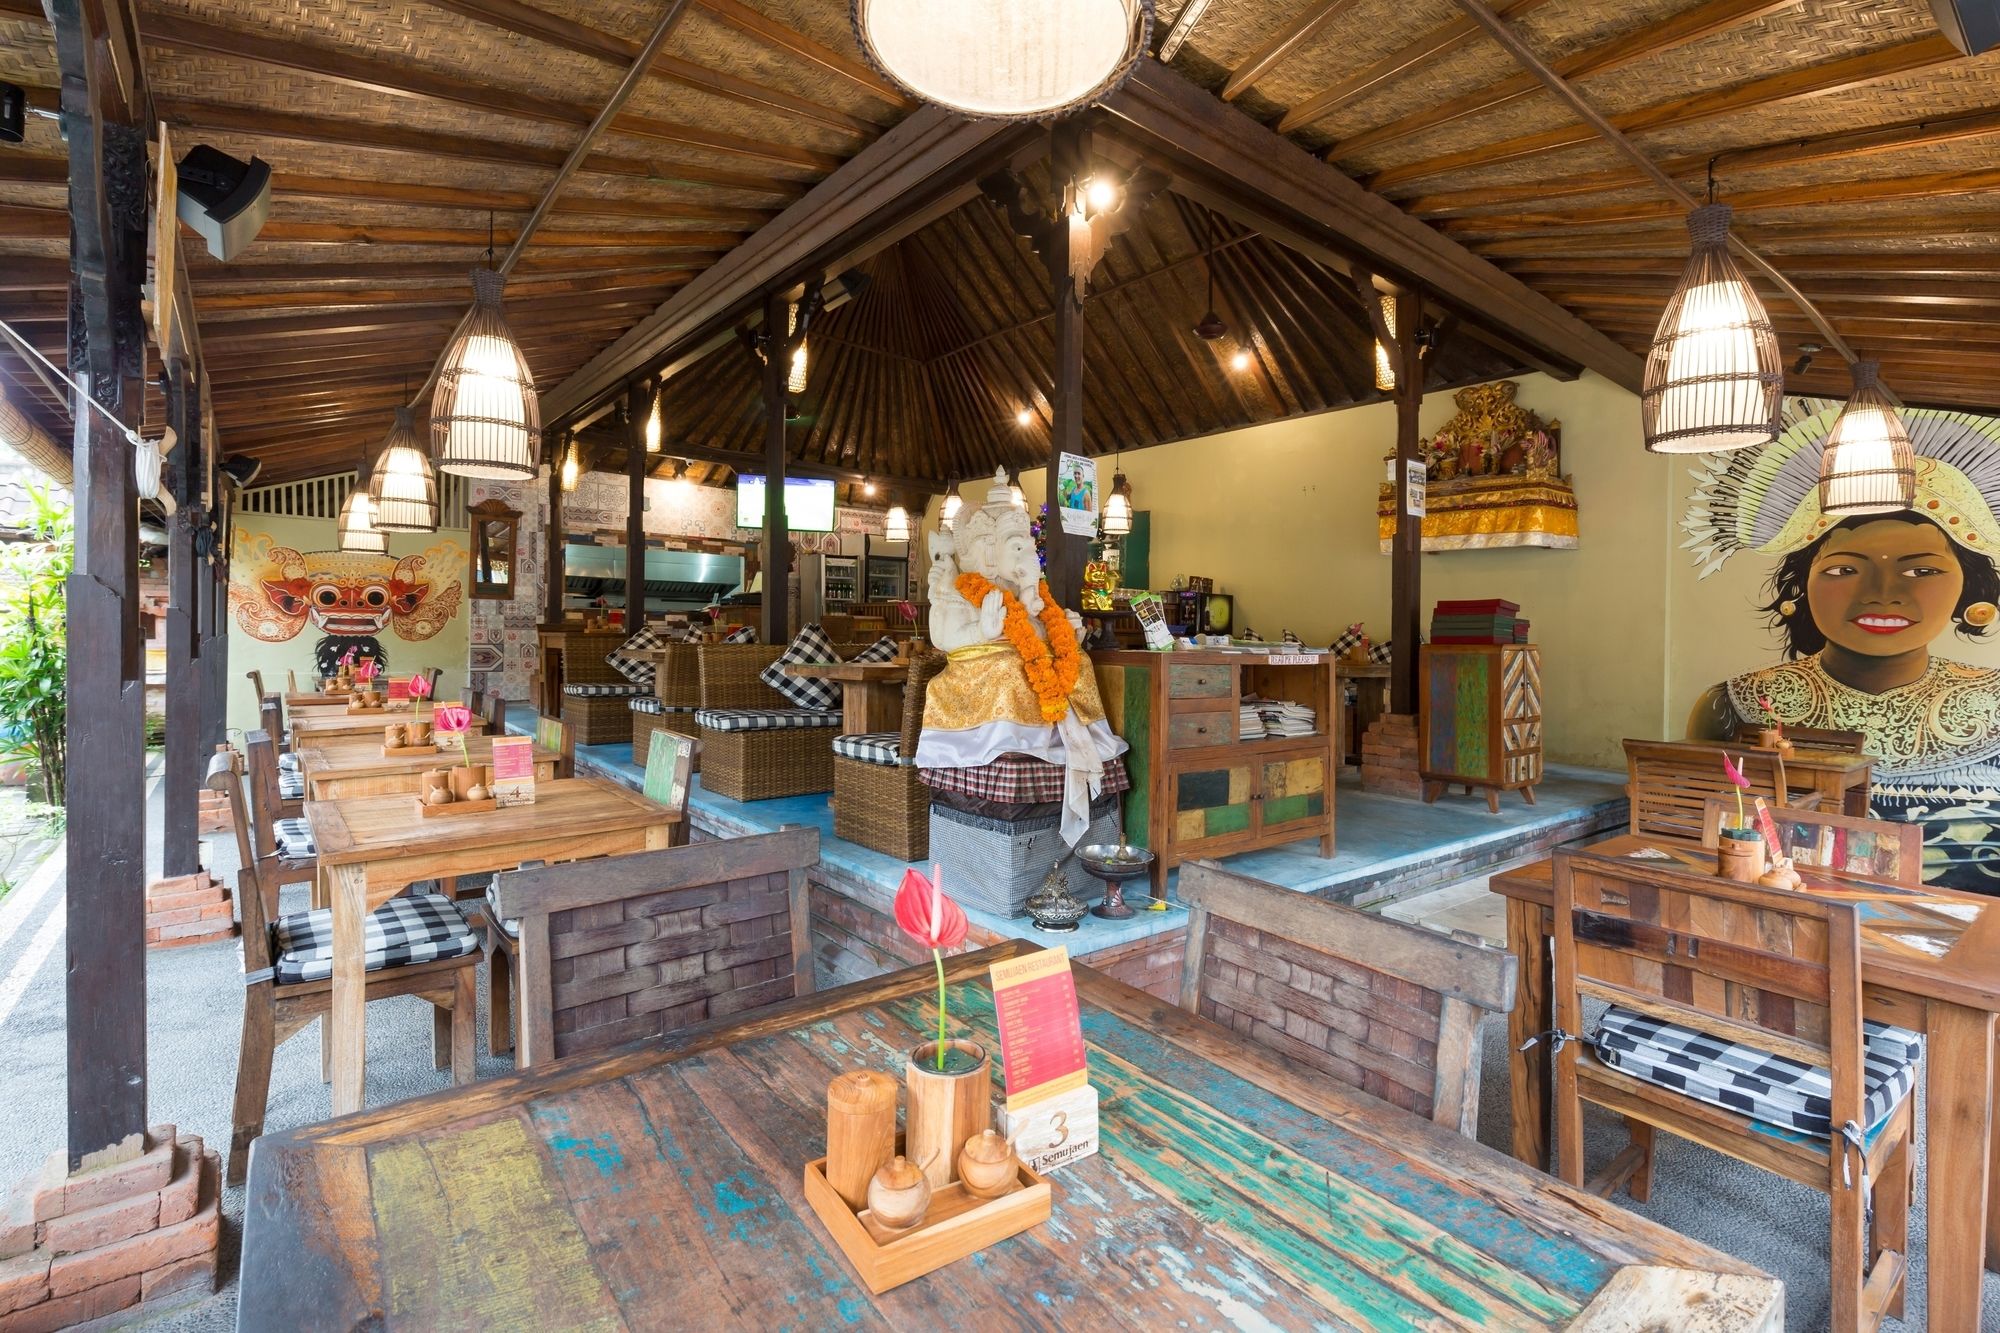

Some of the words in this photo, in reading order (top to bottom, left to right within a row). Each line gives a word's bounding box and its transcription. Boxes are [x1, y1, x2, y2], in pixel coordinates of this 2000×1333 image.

[510, 785, 521, 798] 4
[995, 963, 1028, 981] SEMUJAEN
[1028, 953, 1065, 972] RESTAURANT
[1049, 1110, 1069, 1148] 3
[1042, 1140, 1089, 1166] Semujaen
